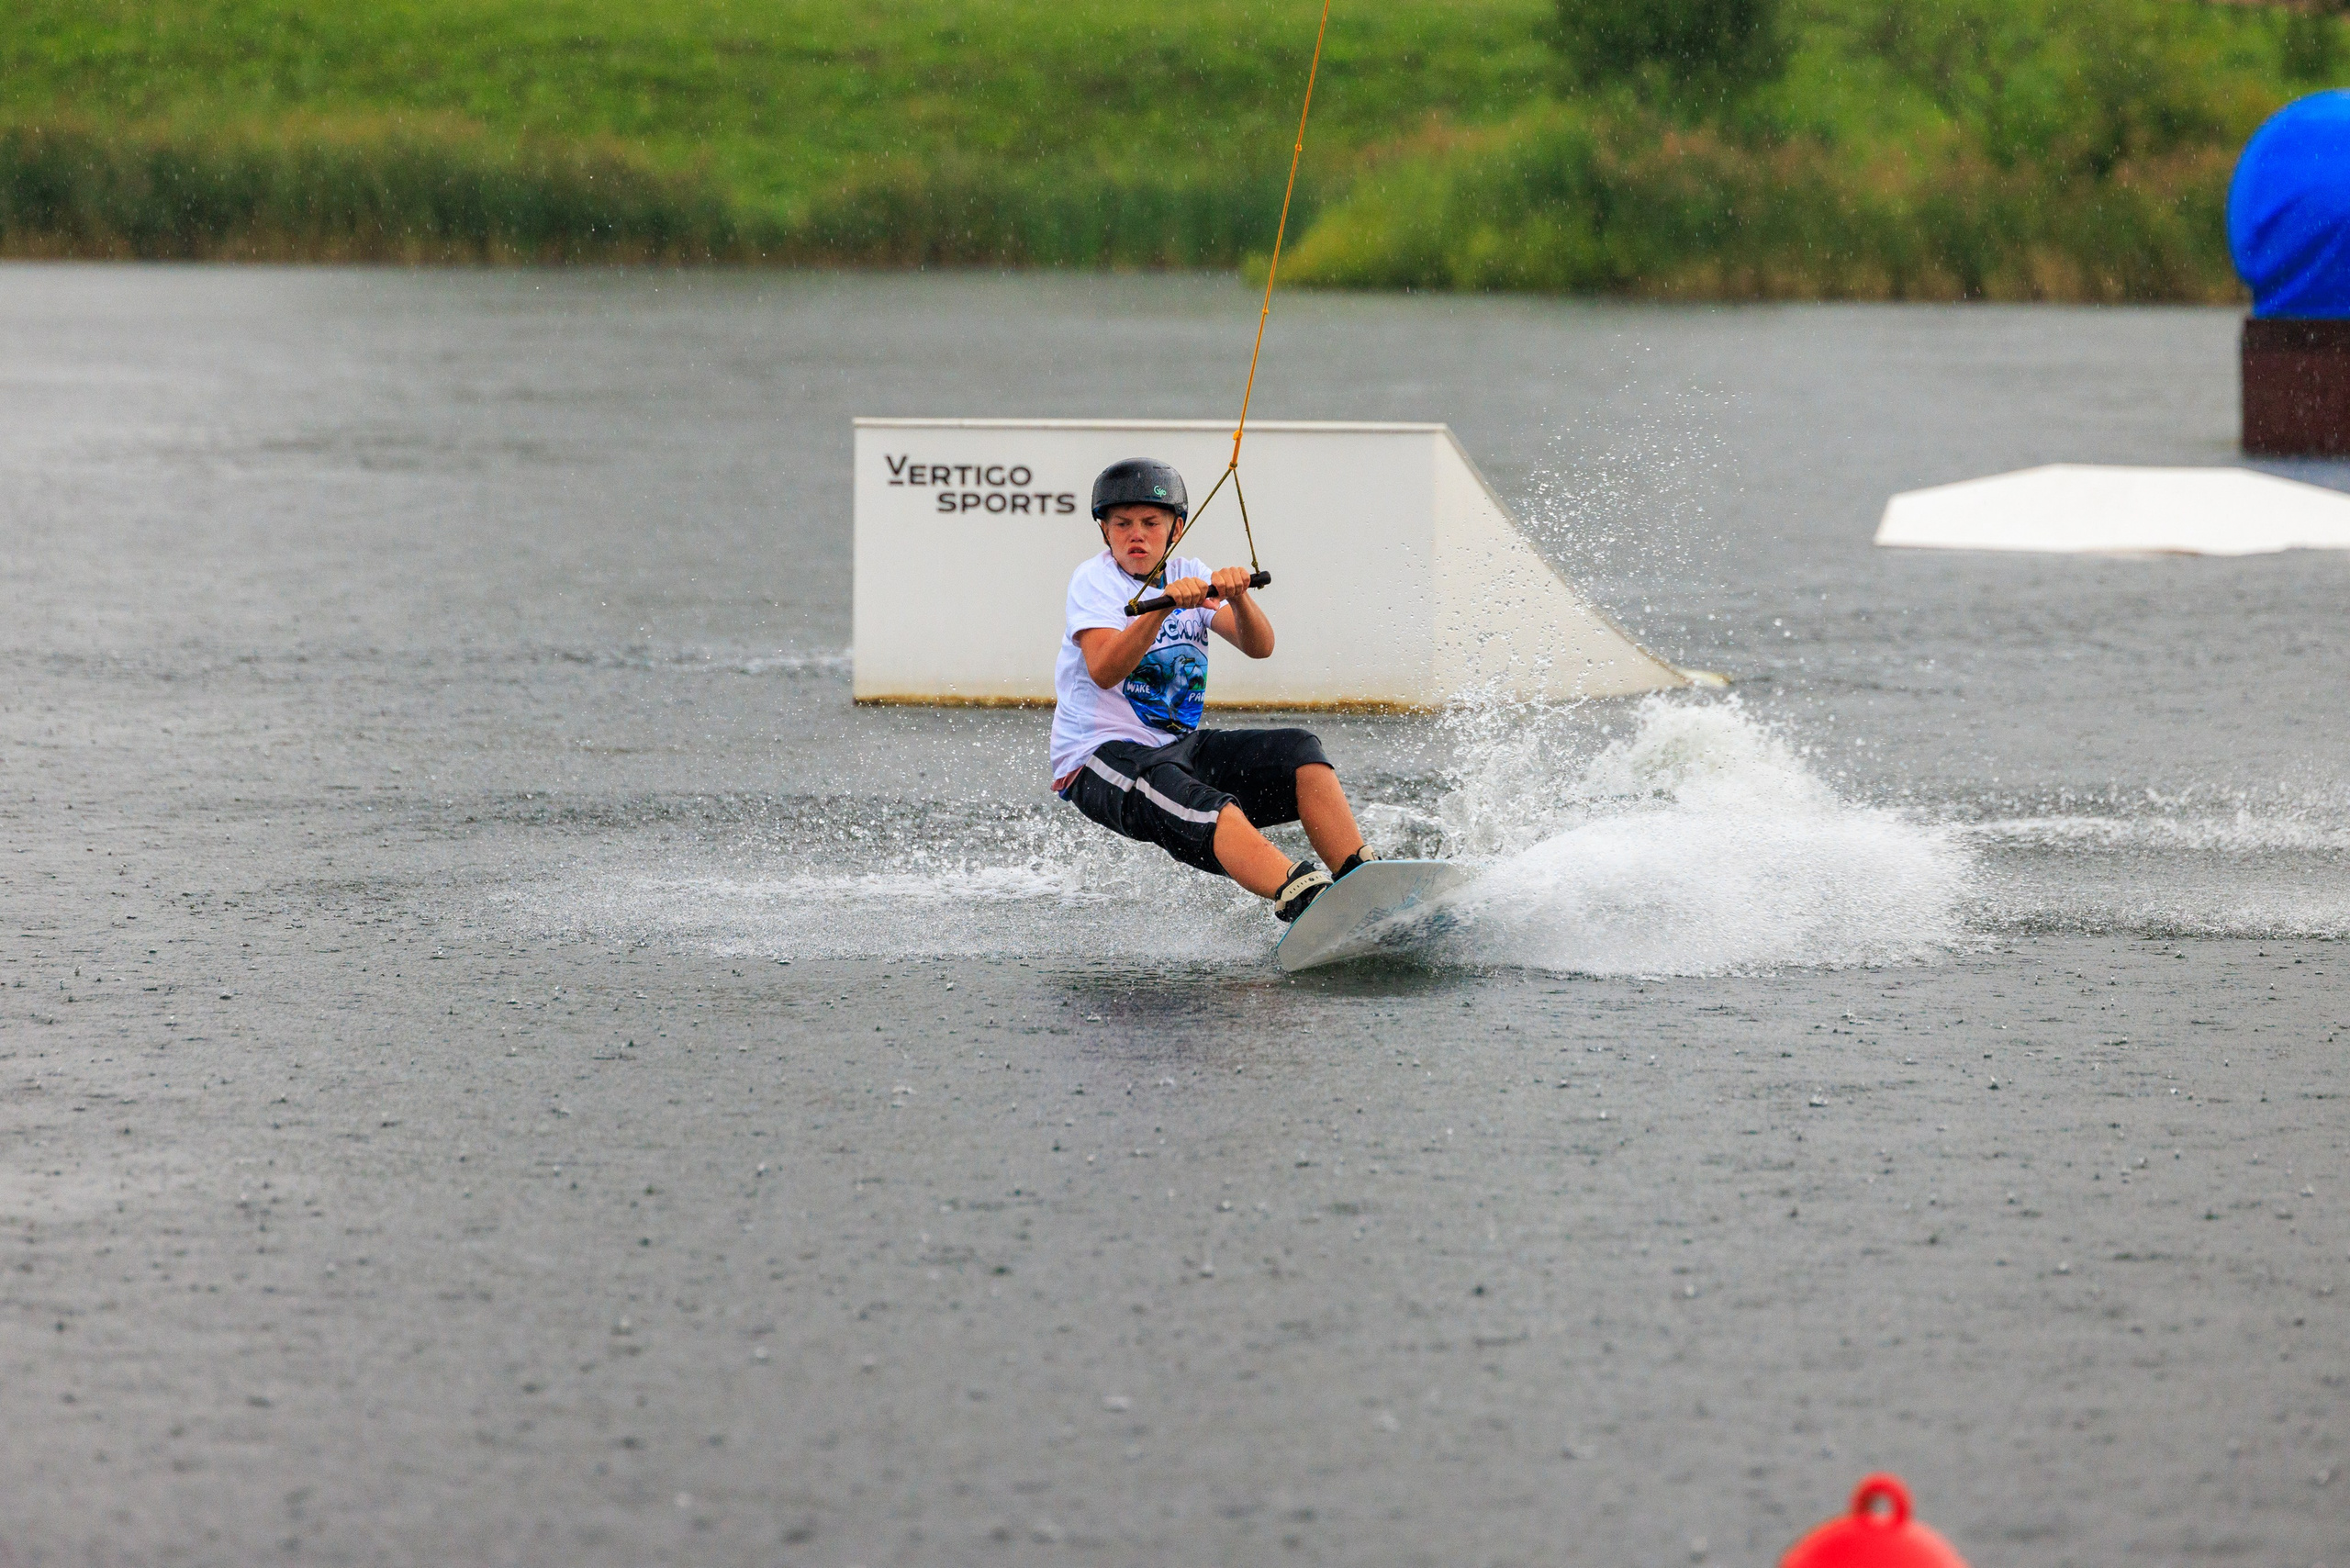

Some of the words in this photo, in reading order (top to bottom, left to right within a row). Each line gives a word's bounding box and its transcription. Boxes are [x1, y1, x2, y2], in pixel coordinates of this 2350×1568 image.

[885, 454, 1032, 487] VERTIGO
[937, 492, 1076, 514] SPORTS
[1126, 681, 1150, 694] WAKE
[1188, 691, 1204, 702] PAR
